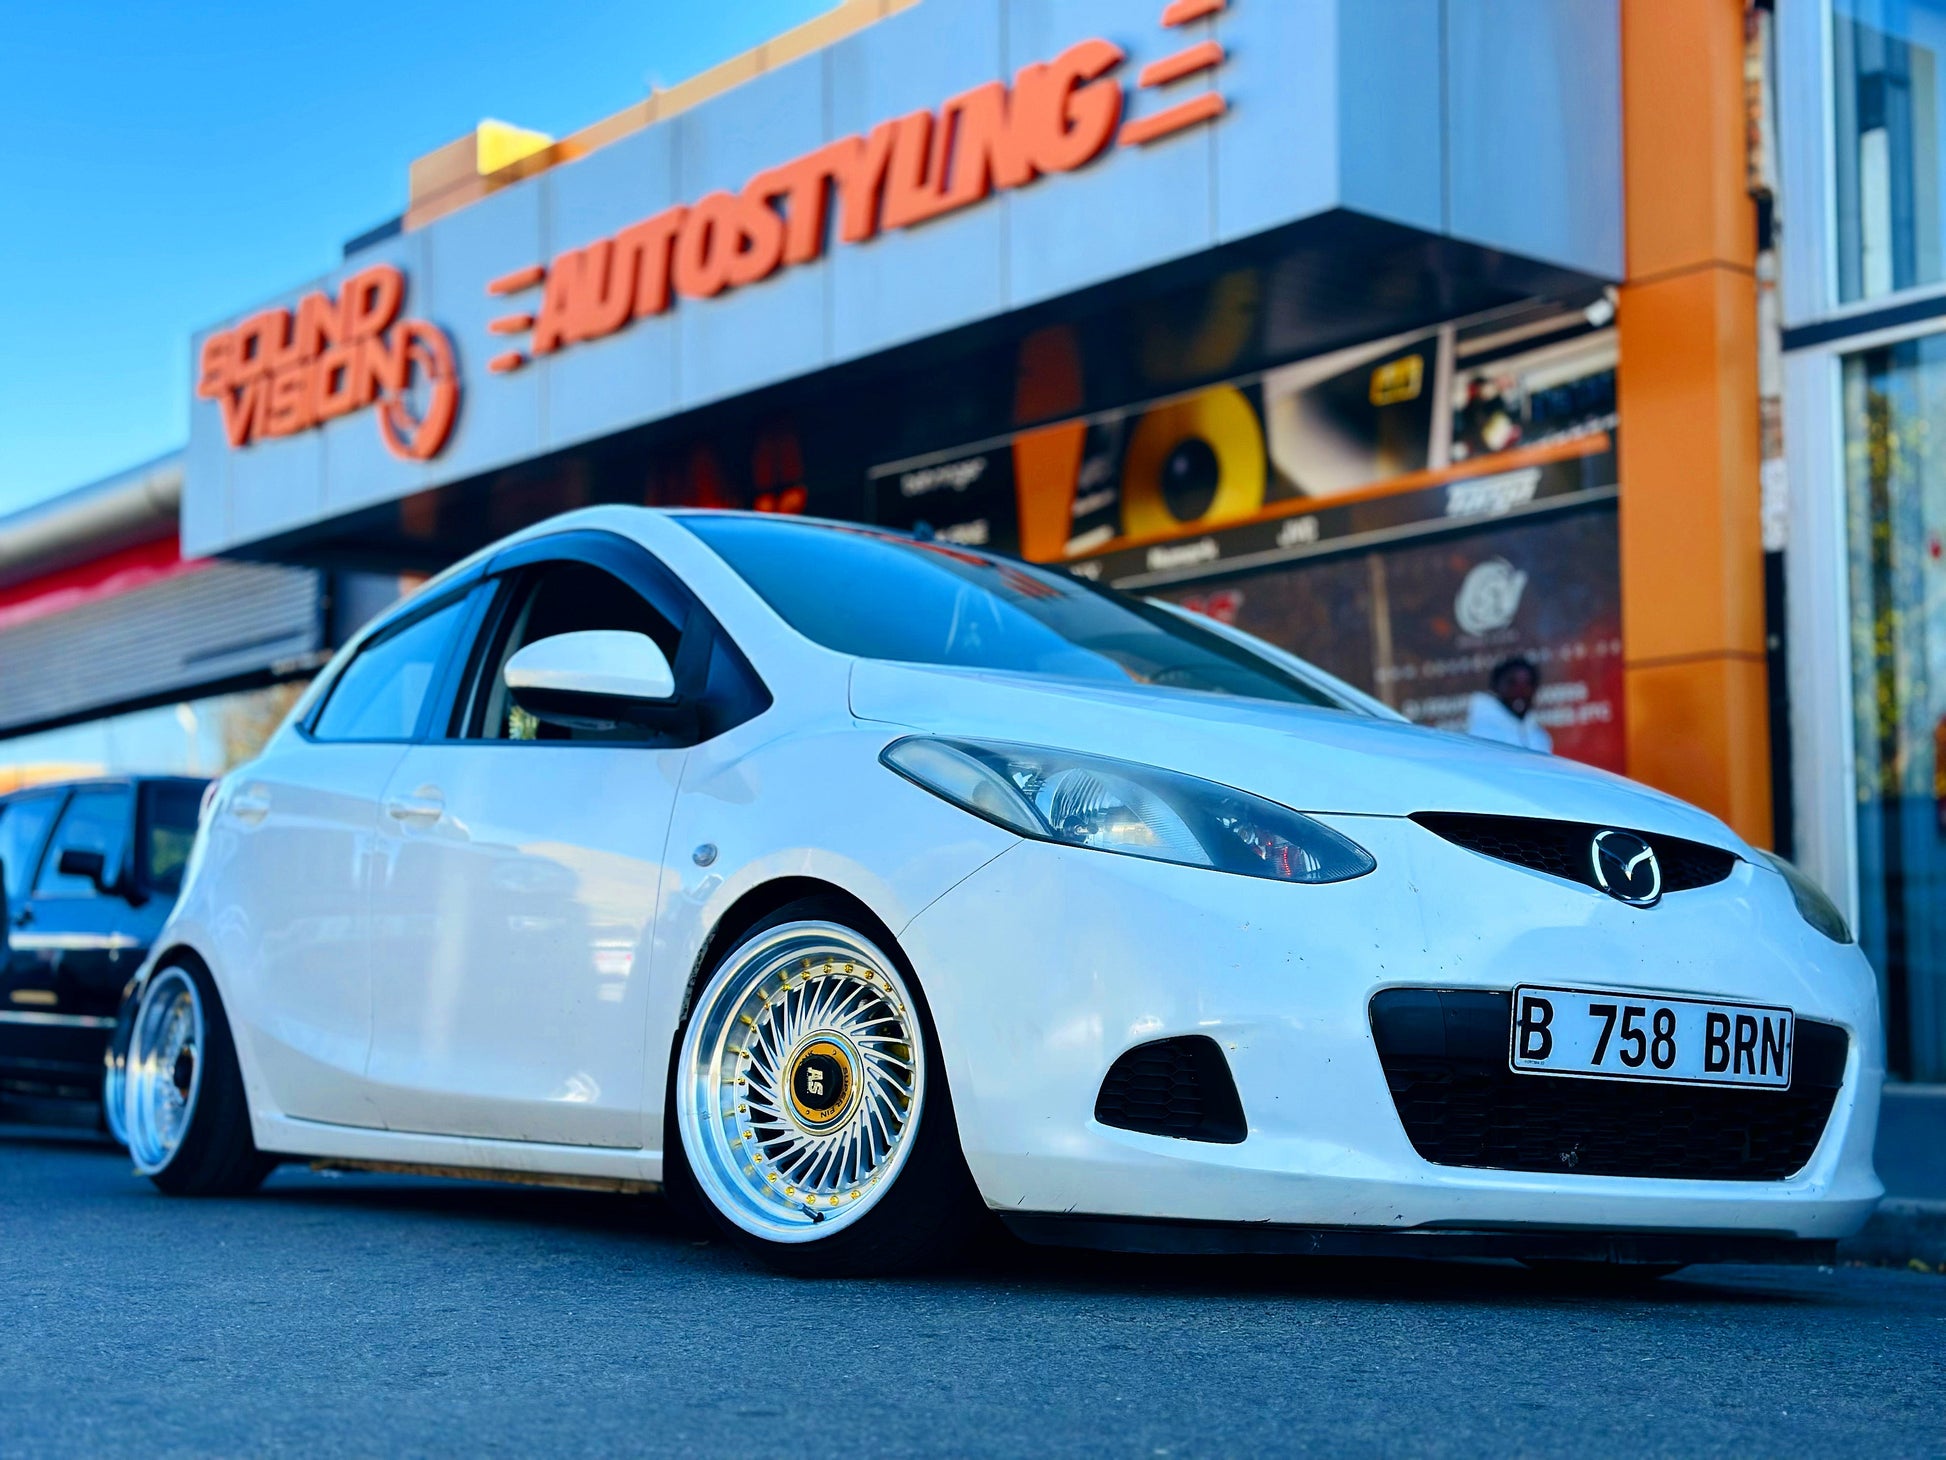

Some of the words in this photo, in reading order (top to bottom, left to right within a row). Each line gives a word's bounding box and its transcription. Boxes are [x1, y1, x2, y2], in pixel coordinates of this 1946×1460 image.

[531, 38, 1124, 357] AUTOSTYLING
[199, 264, 405, 397] SOUND
[219, 321, 411, 447] VISION
[1519, 996, 1554, 1060] B
[1589, 1003, 1676, 1070] 758
[1704, 1011, 1786, 1077] BRN
